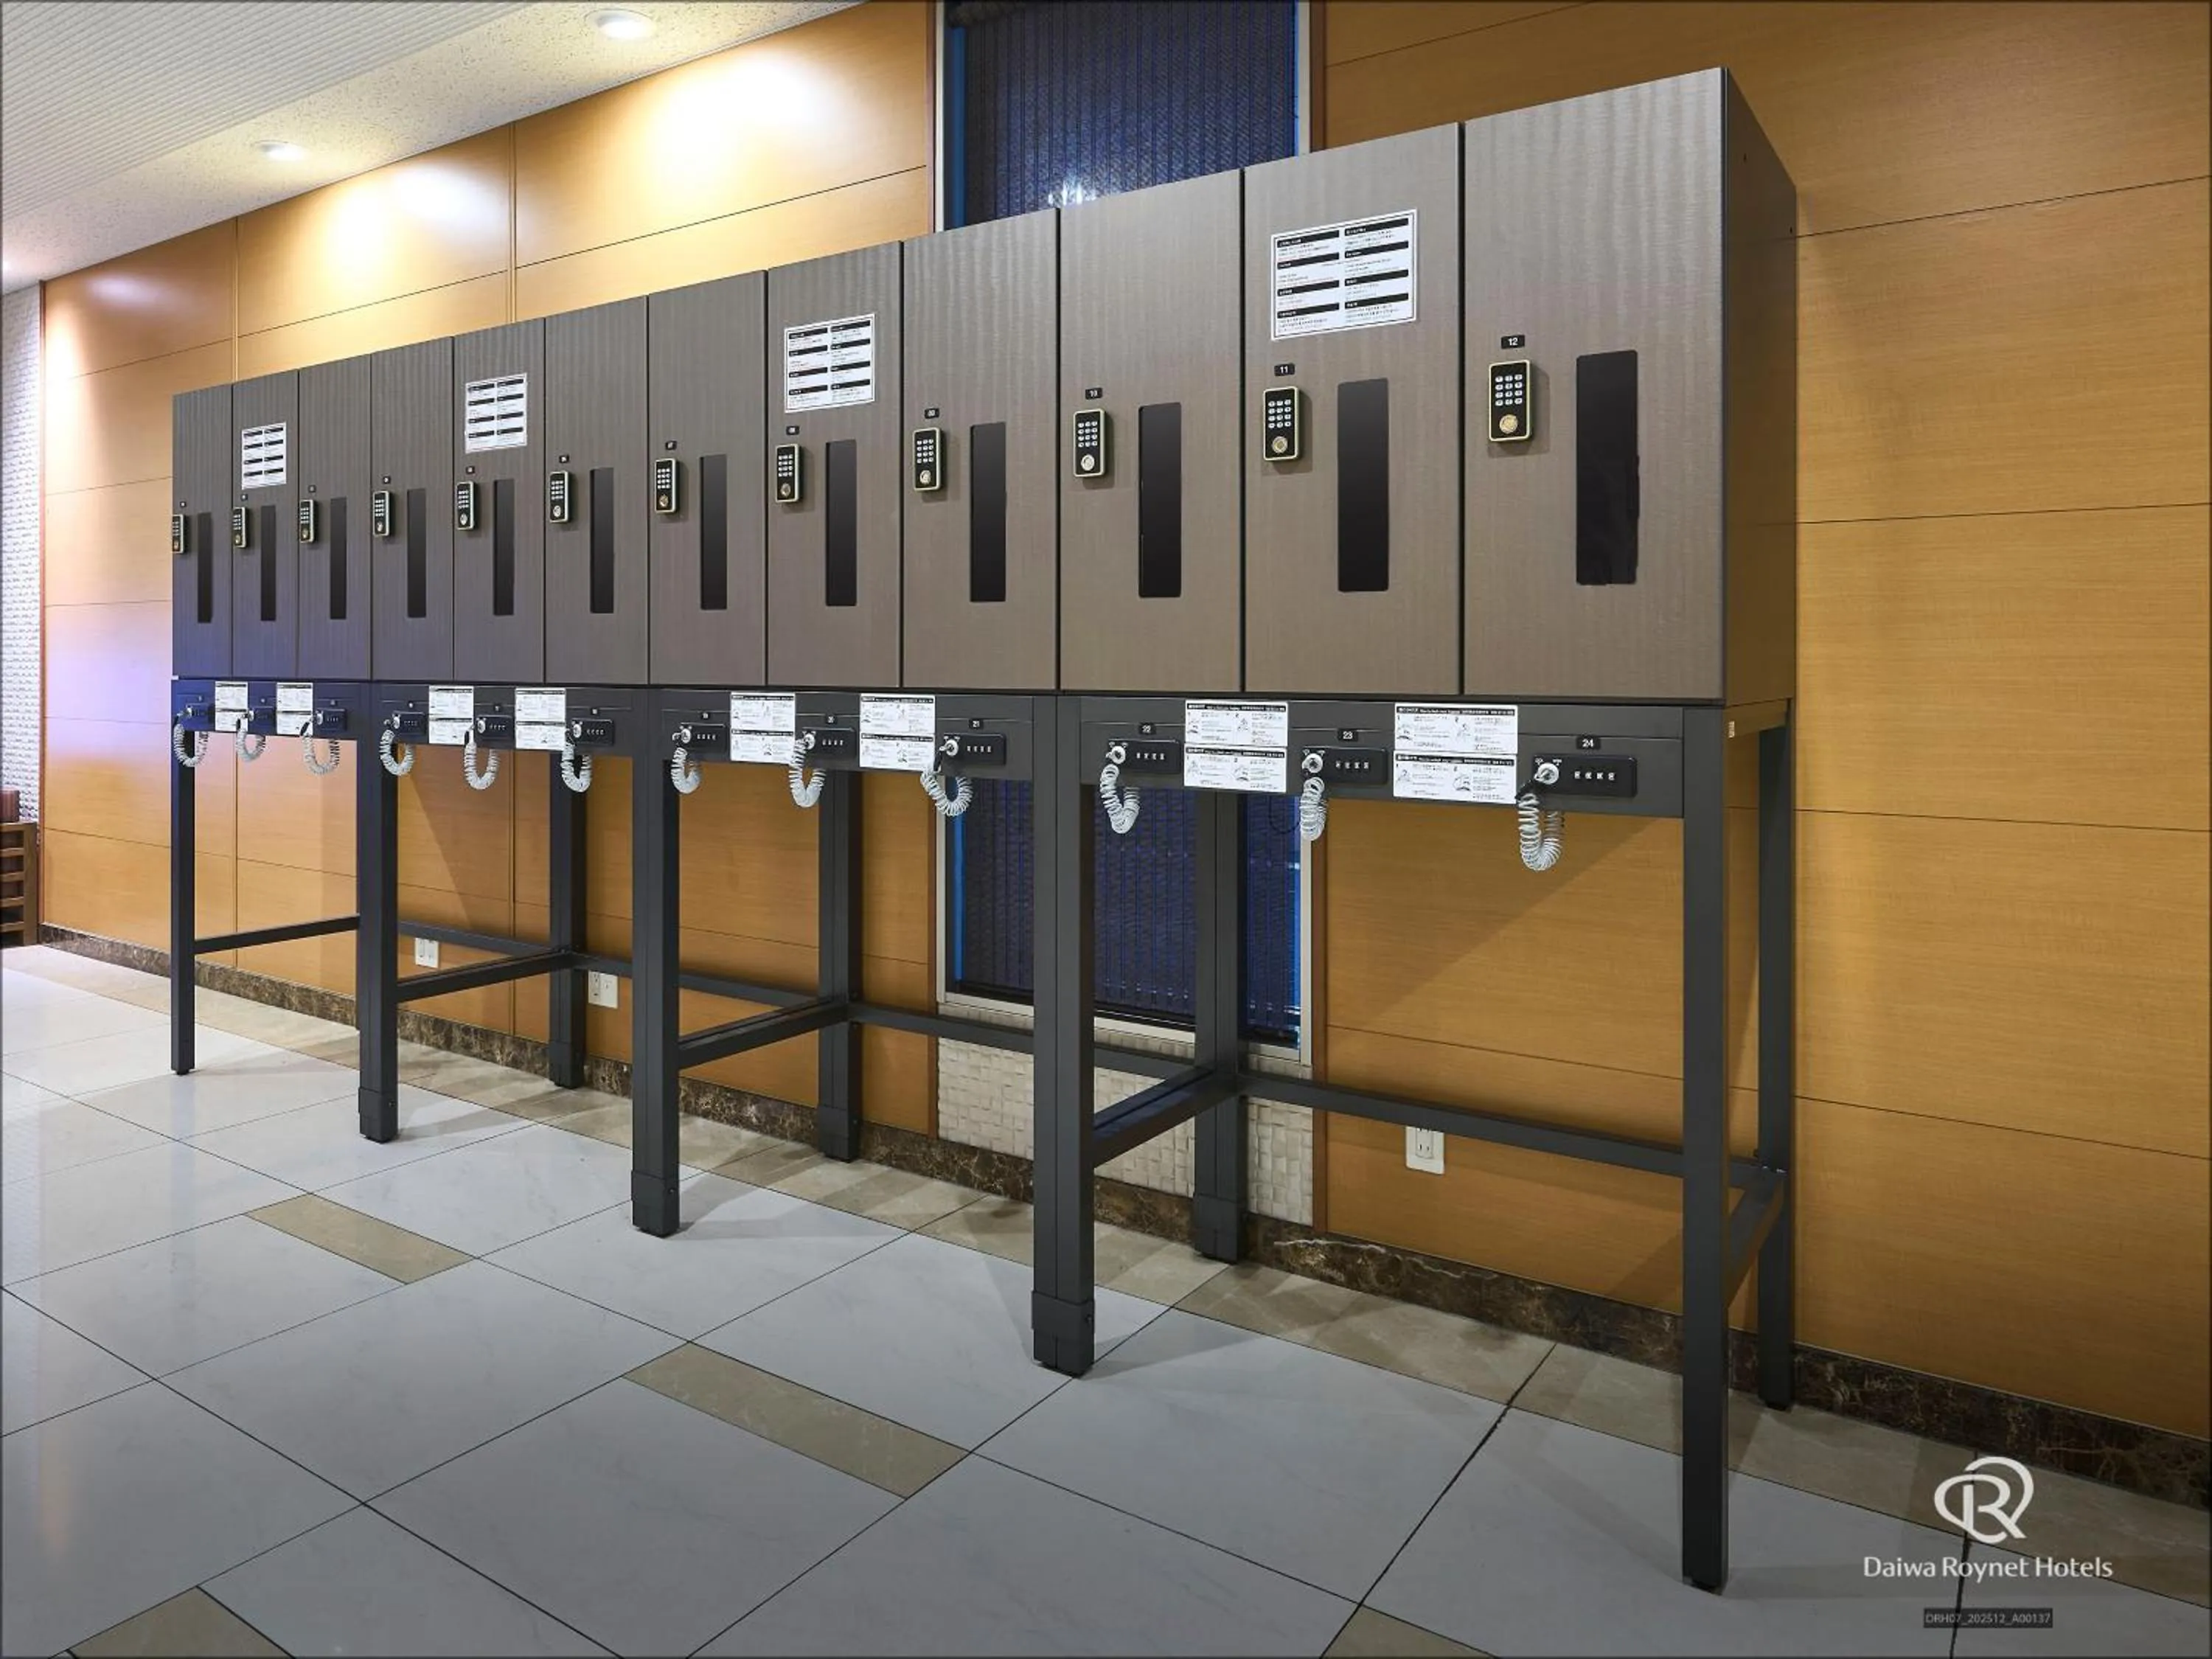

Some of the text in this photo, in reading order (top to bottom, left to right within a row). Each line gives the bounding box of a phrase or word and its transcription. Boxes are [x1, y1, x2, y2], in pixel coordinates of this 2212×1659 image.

[1508, 337, 1518, 346] 12
[1279, 366, 1289, 374] 11
[1343, 731, 1353, 740] 23
[1582, 738, 1594, 748] 24
